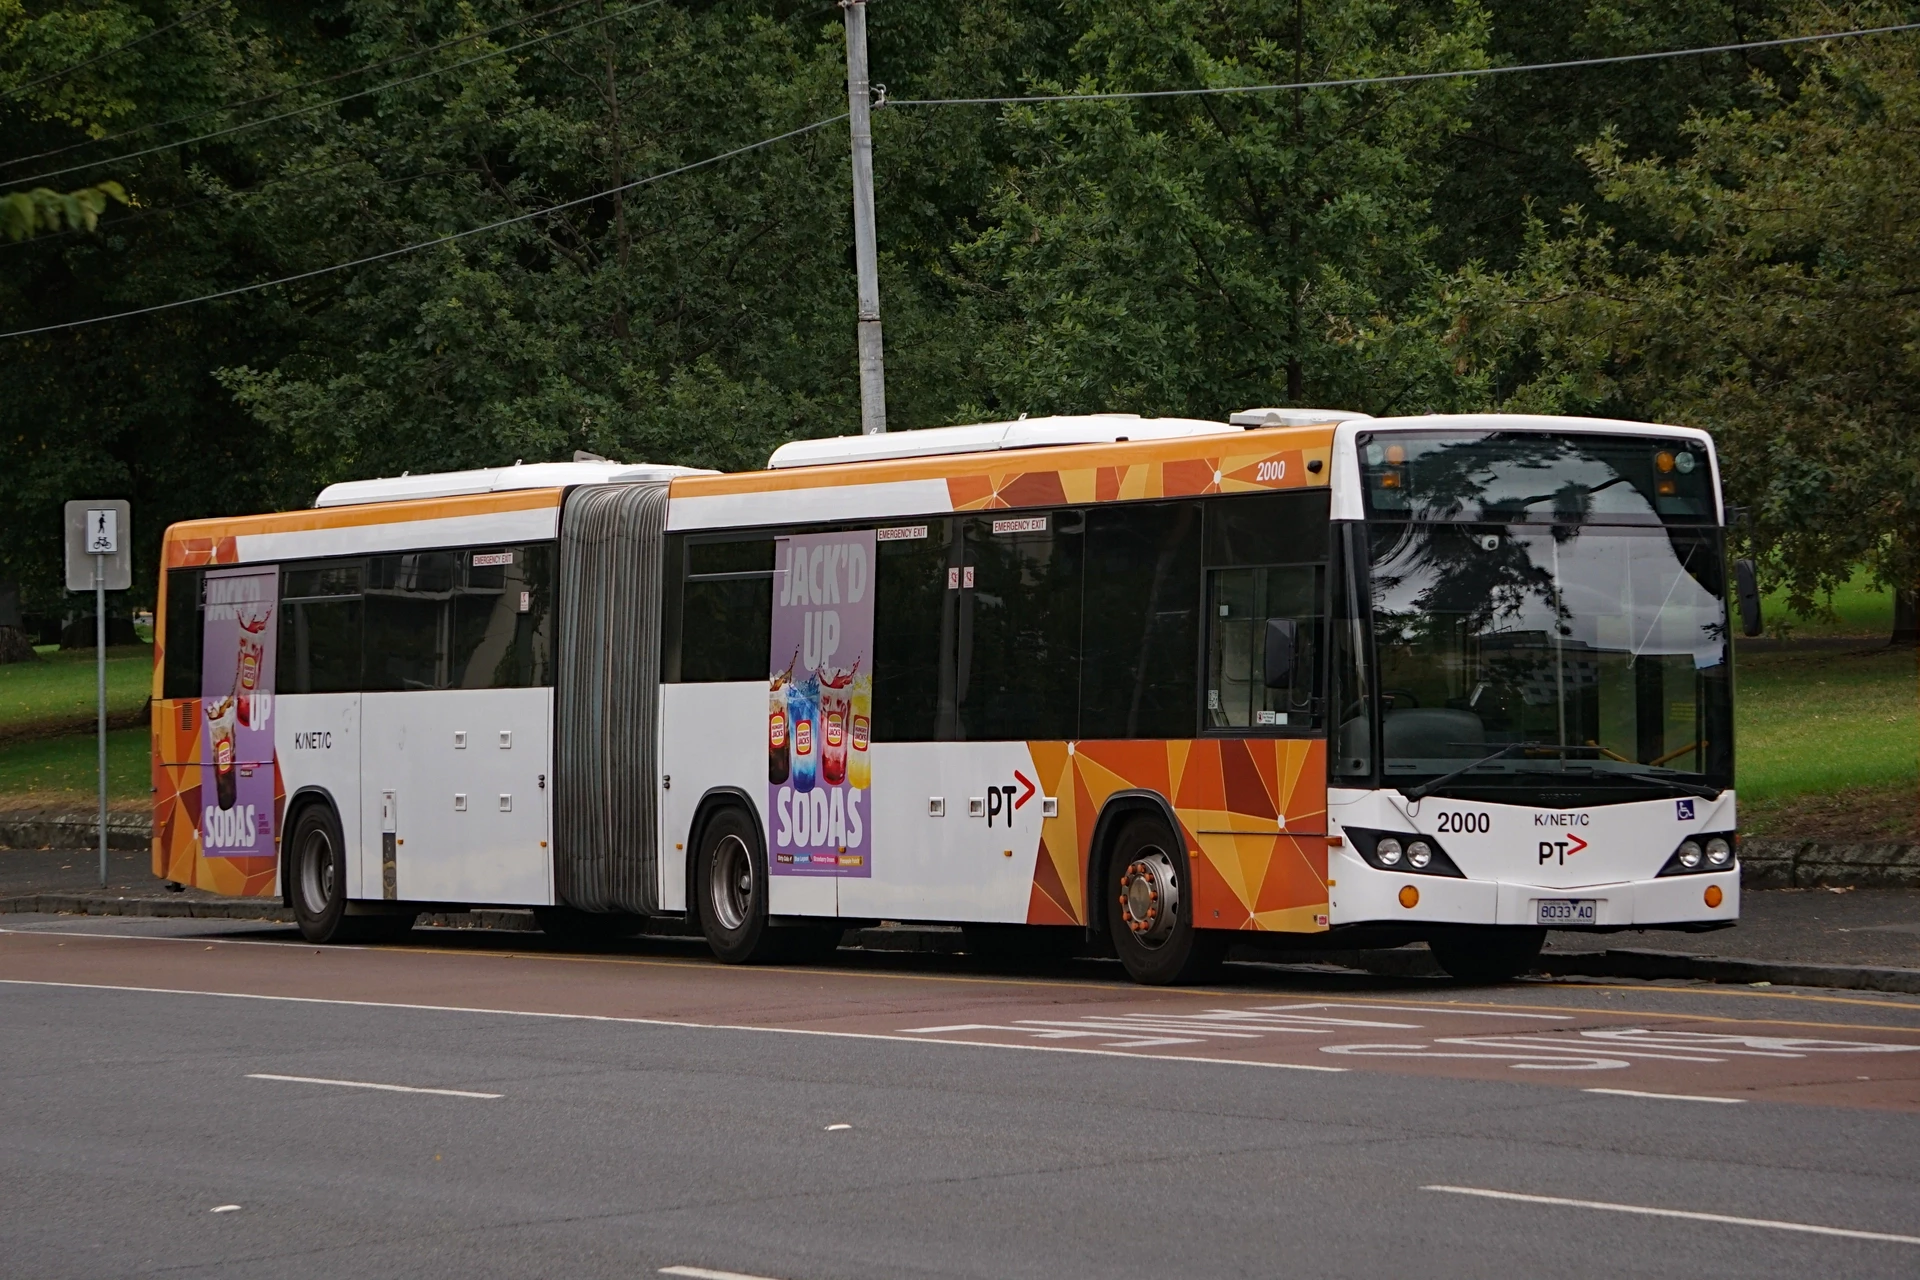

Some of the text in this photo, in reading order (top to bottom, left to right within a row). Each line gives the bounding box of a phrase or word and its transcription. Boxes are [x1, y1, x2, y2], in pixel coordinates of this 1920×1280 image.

[1256, 460, 1286, 482] 2000
[878, 526, 927, 539] EMERGENCY EXIT
[995, 518, 1045, 532] EMERGENCY EXIT
[474, 553, 512, 565] EMERGENCY EXIT
[780, 543, 867, 607] JACK'D
[803, 610, 841, 671] UP
[250, 688, 272, 731] UP
[205, 804, 256, 848] SODAS
[777, 786, 863, 848] SODAS
[1437, 812, 1490, 833] 2000
[1541, 905, 1571, 918] 8033
[895, 1002, 1576, 1048] LANE
[1318, 1028, 1920, 1070] BUS
